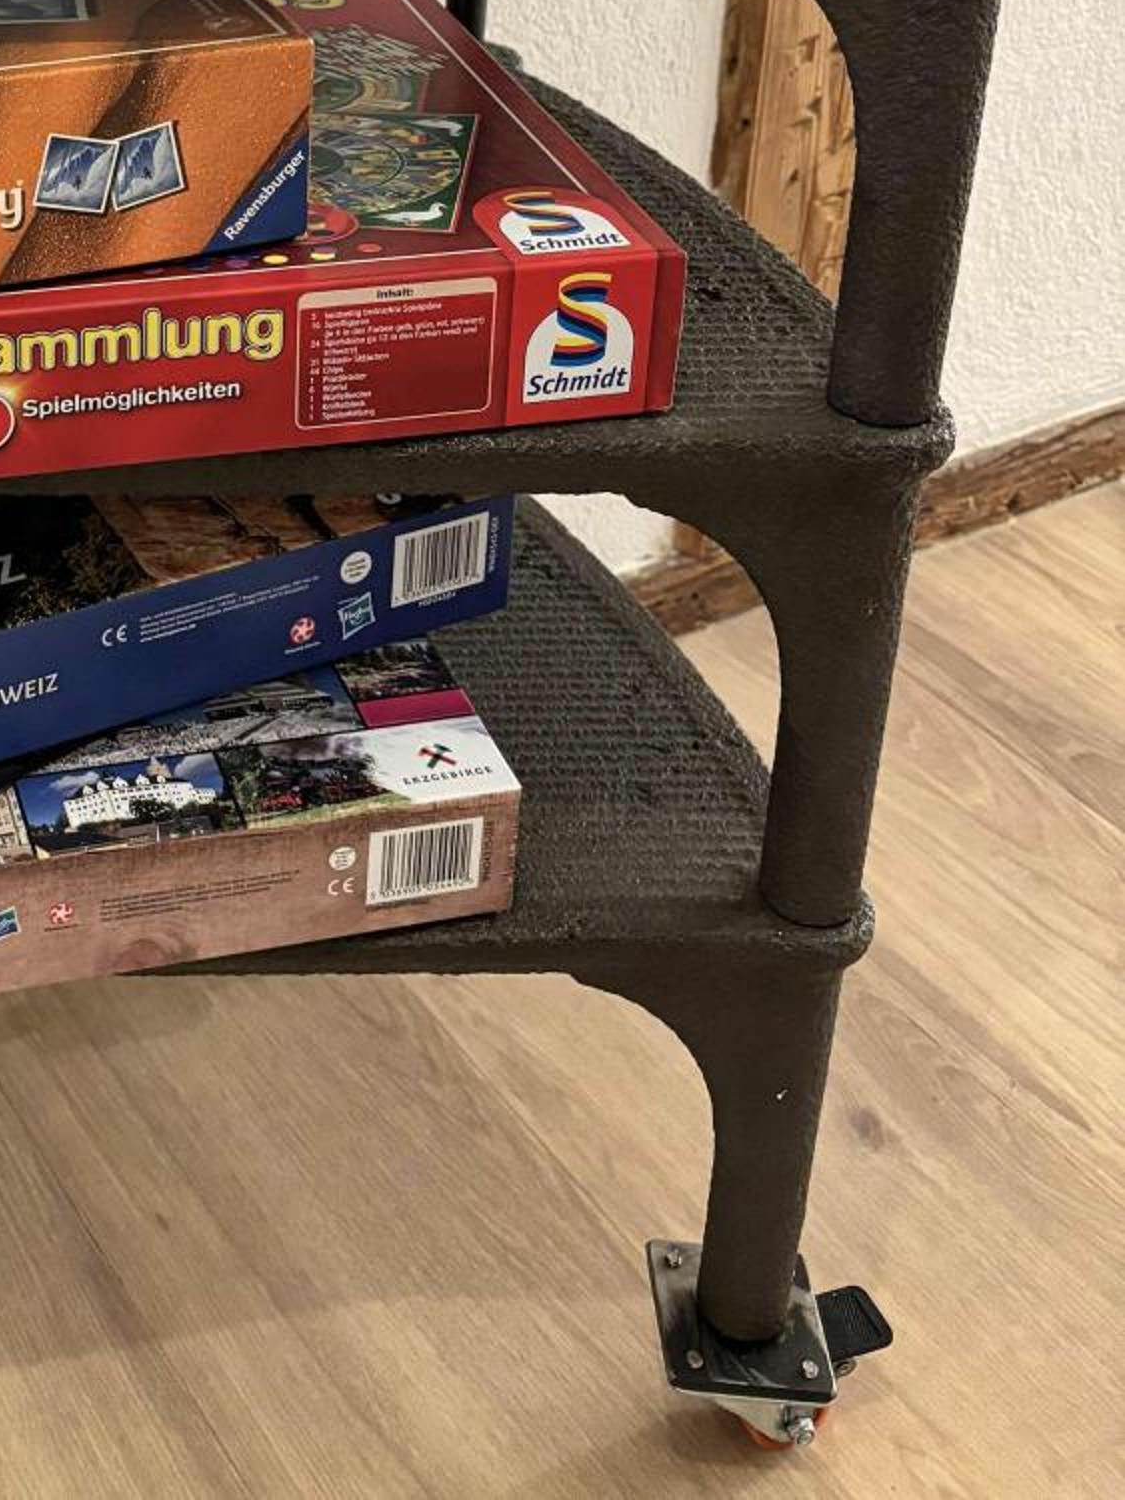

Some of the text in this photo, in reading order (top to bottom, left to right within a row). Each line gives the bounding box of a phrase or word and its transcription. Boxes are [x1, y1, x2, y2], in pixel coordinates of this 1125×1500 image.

[222, 147, 307, 243] Ravensburger
[519, 230, 624, 255] Schmidt
[376, 288, 414, 299] Inhalt:
[526, 367, 630, 397] Schmidt
[21, 379, 242, 420] Spielmöglichkeiten
[402, 764, 494, 787] ERZGEBIRGE
